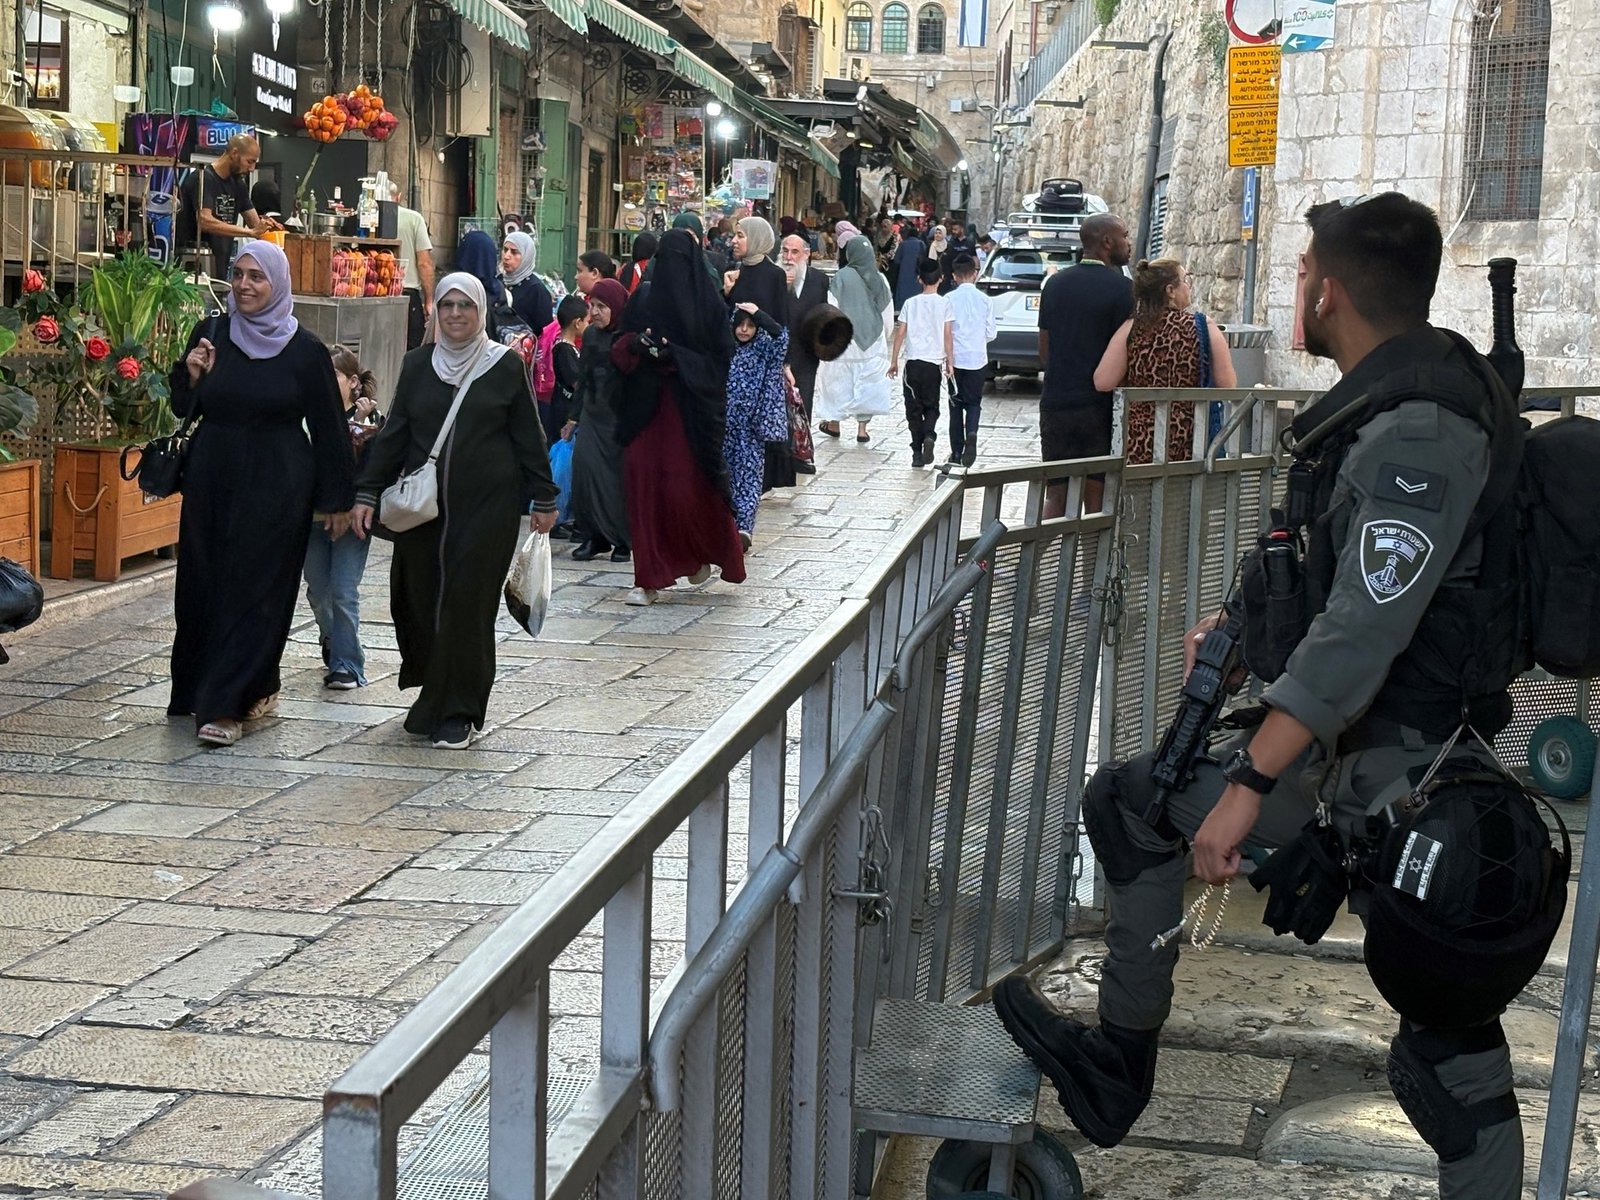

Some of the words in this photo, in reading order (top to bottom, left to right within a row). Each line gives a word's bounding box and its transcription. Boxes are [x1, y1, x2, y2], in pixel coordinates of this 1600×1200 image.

[1293, 11, 1308, 23] 100
[312, 80, 325, 90] 64
[1231, 111, 1245, 119] לרכב
[1371, 526, 1401, 536] ישראל
[1400, 529, 1426, 552] משטרת
